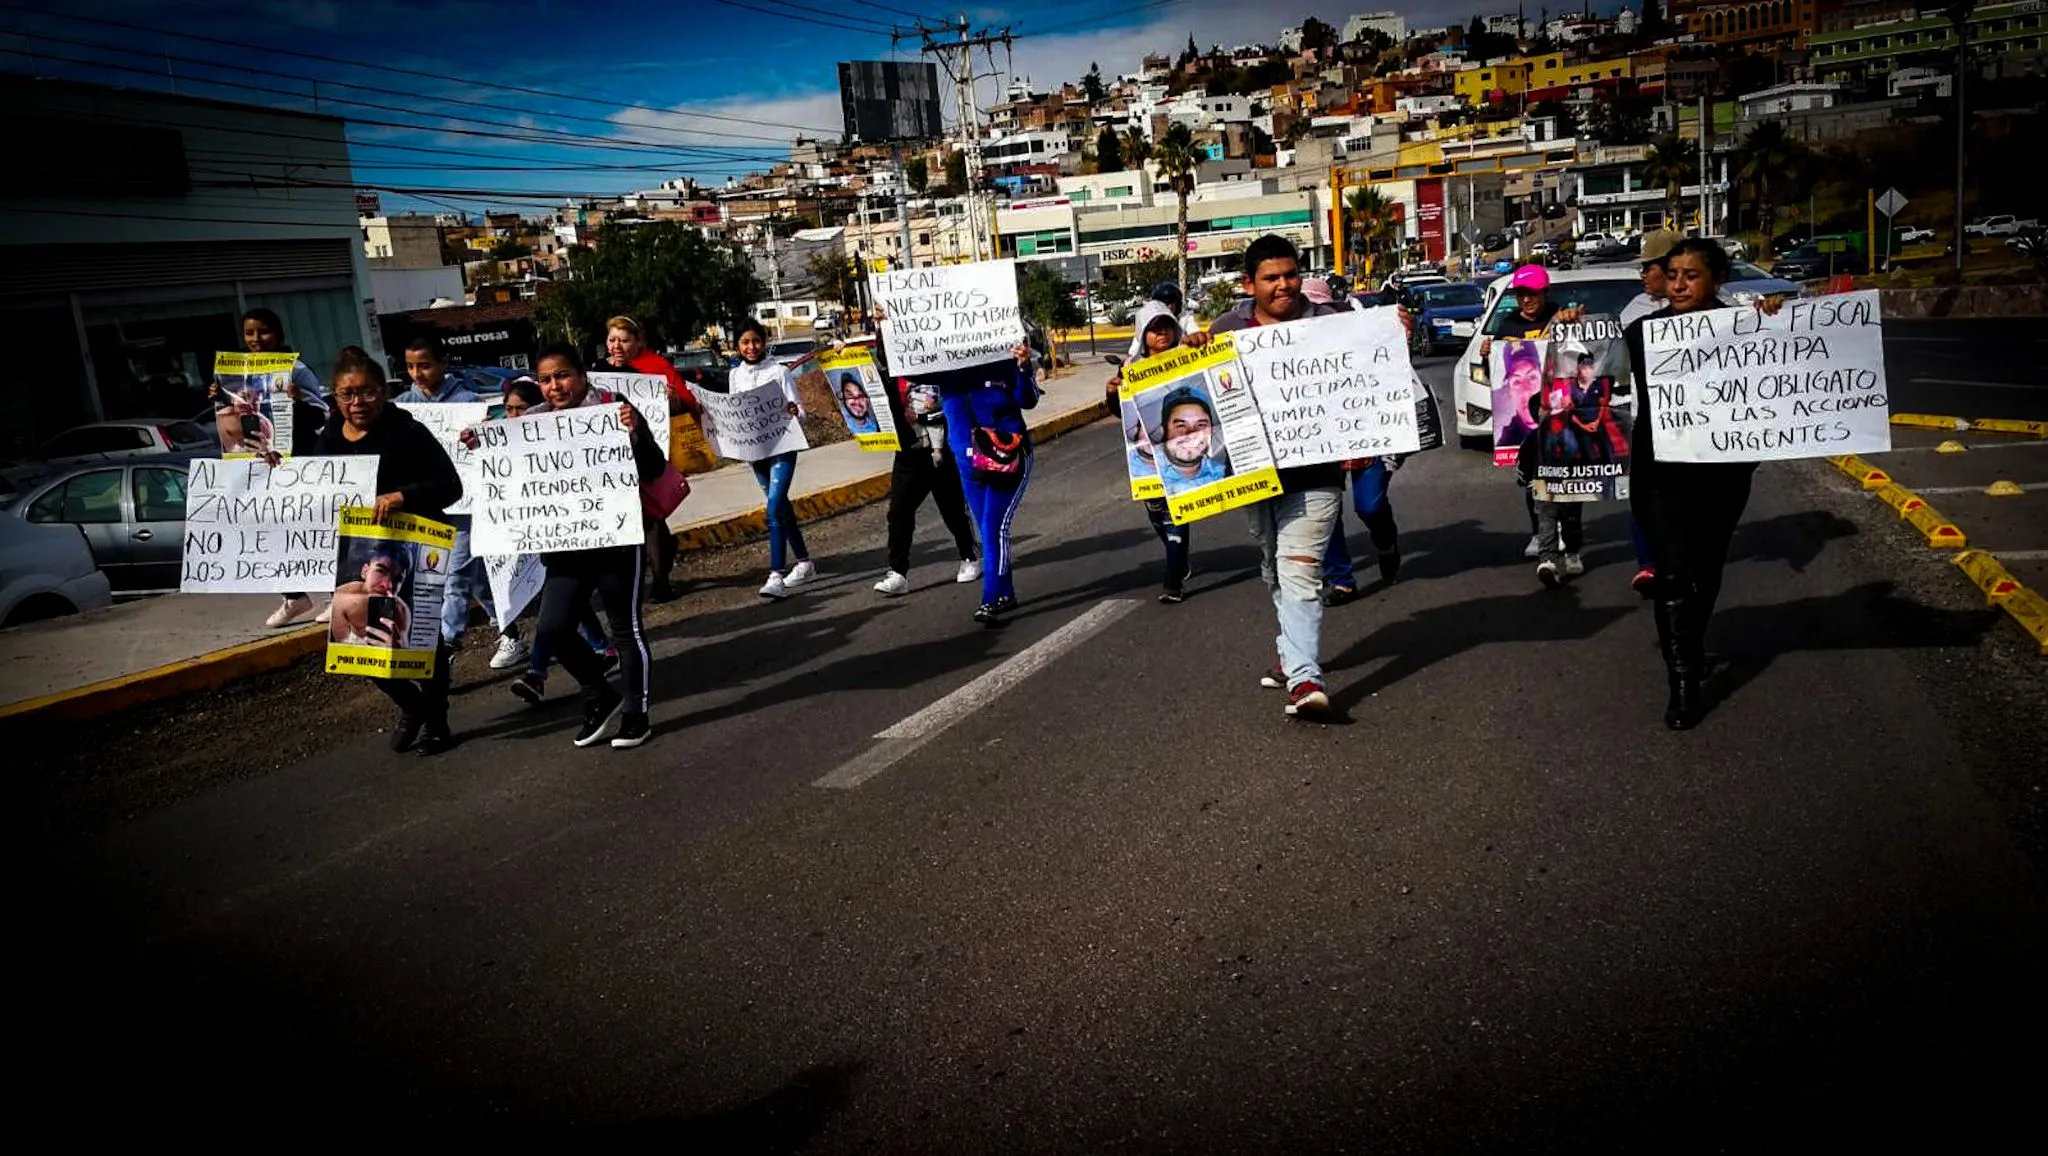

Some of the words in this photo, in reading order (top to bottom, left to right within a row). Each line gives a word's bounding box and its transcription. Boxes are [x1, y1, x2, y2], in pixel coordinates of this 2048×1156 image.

[1102, 250, 1134, 261] HSBC
[876, 271, 940, 293] FISCAL
[886, 289, 989, 318] NUESTROS
[892, 315, 942, 337] HIJOS
[1649, 314, 1715, 343] PARA
[1733, 309, 1772, 335] EL
[1790, 298, 1883, 332] FISCAL
[447, 334, 473, 346] con
[473, 330, 509, 344] rosas
[894, 336, 926, 354] SON
[1239, 328, 1294, 355] SCAL
[1373, 346, 1391, 364] A
[1651, 335, 1830, 377] ZAMARRIPA
[1649, 383, 1686, 410] NO
[1701, 376, 1748, 408] SON
[1757, 368, 1878, 400] OBLIGATO
[1270, 404, 1326, 424] UMPLA
[1342, 395, 1376, 410] CON
[1386, 388, 1411, 401] LOS
[1659, 410, 1711, 431] RIAS
[1731, 405, 1777, 421] LAS
[475, 424, 508, 449] HOY
[521, 420, 547, 443] EL
[556, 413, 628, 441] FISCAL
[1274, 422, 1322, 443] RDOS
[1334, 418, 1364, 434] DE
[1377, 410, 1411, 427] DIA
[1710, 421, 1851, 451] URGENTES
[189, 460, 226, 490] AL
[246, 459, 358, 491] FISCAL
[481, 454, 513, 479] NO
[524, 450, 574, 474] TUVO
[1571, 463, 1623, 478] JUSTICIA
[481, 483, 506, 501] DE
[521, 477, 592, 499] ATENDER
[602, 472, 616, 490] A
[1566, 480, 1604, 495] ELLOS
[187, 492, 364, 525] ZAMARRIPA
[488, 504, 570, 525] VICTIMAS
[578, 497, 605, 513] DE
[1178, 503, 1195, 514] POR
[1195, 492, 1223, 508] SIEMPRE
[1225, 489, 1236, 500] TE
[186, 529, 223, 555] NO
[239, 530, 272, 555] LE
[183, 560, 226, 583] LOS
[337, 655, 355, 665] POR
